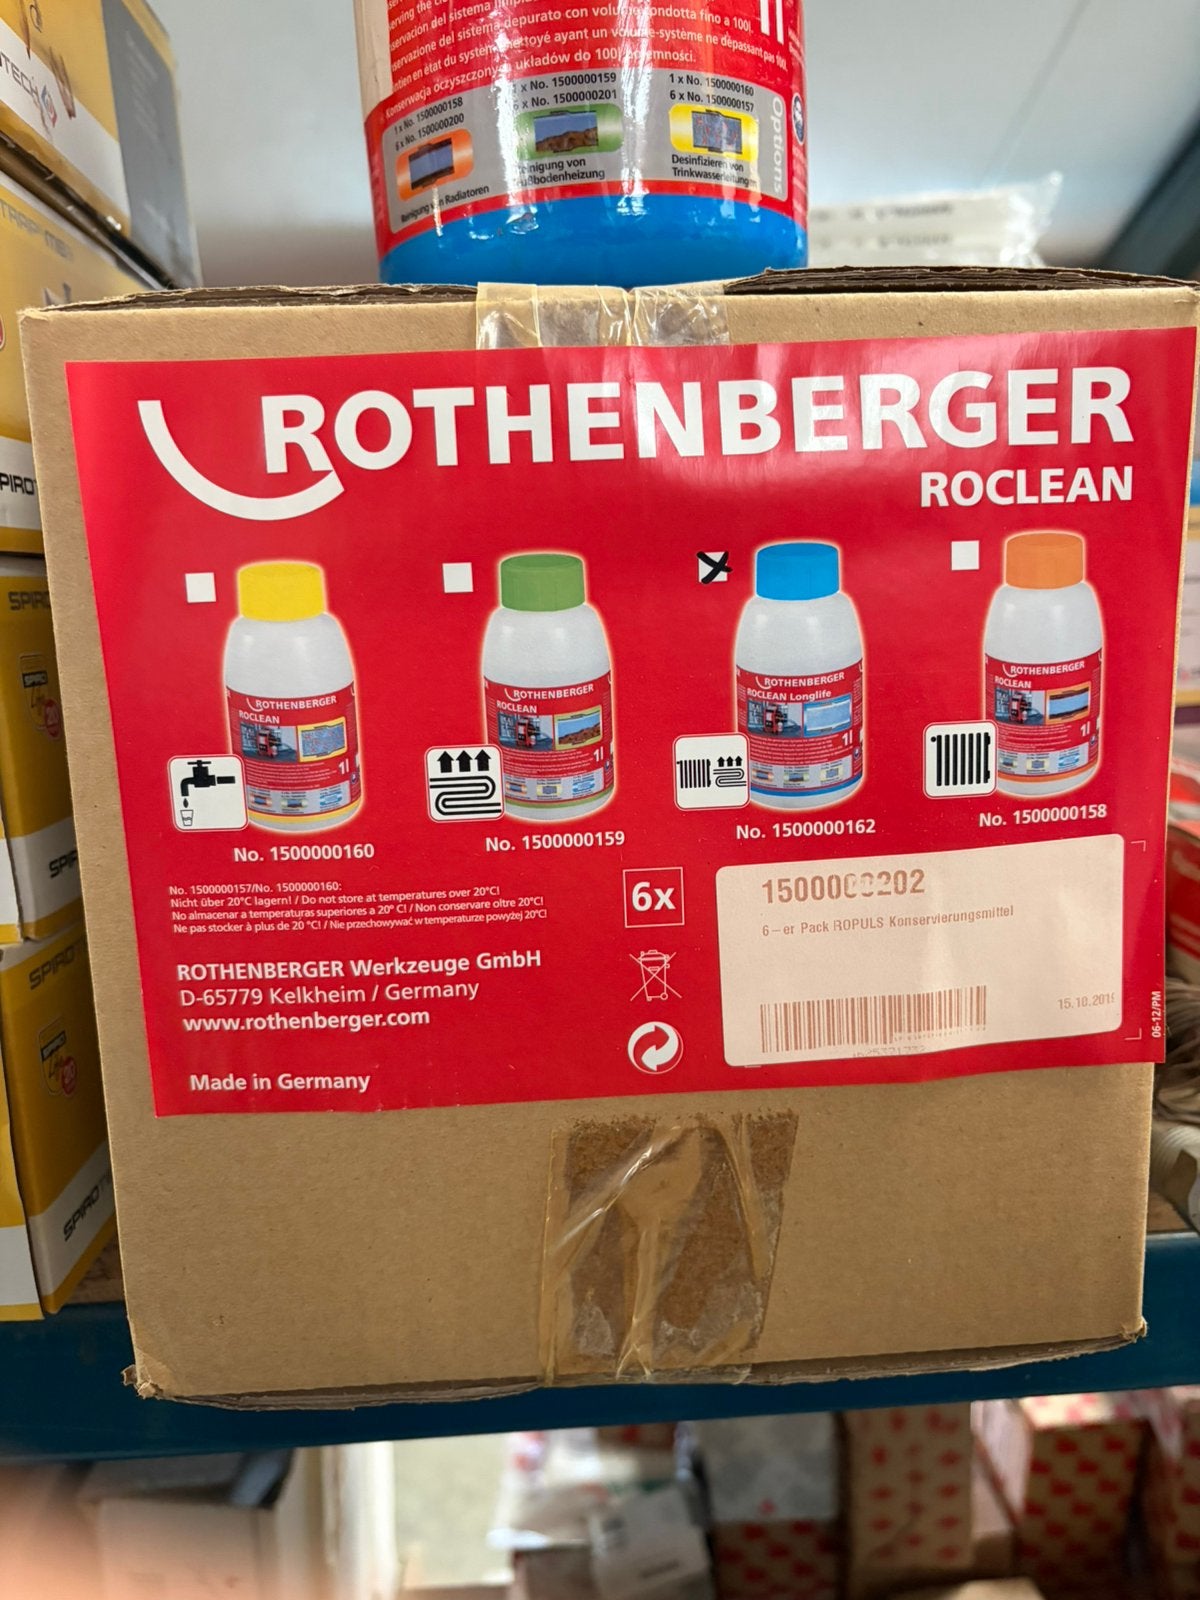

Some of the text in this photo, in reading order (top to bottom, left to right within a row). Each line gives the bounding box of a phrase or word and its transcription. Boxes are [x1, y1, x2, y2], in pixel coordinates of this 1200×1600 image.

[431, 13, 447, 30] del
[448, 2, 491, 21] sistema
[438, 31, 455, 49] del
[457, 20, 500, 42] sistema
[503, 11, 561, 29] depurato
[565, 8, 589, 19] con
[700, 10, 721, 24] fino
[724, 17, 730, 26] a
[412, 67, 423, 81] en
[444, 53, 457, 68] du
[554, 28, 589, 44] ayant
[592, 28, 608, 39] un
[705, 33, 719, 45] ne
[515, 53, 570, 72] układów
[573, 50, 591, 62] do
[520, 83, 528, 92] x
[530, 79, 549, 91] No.
[552, 72, 617, 88] 1500000159
[669, 73, 754, 97] 1 x No. 1500000160
[521, 99, 529, 109] x
[531, 96, 550, 107] No.
[553, 88, 617, 104] 1500000201
[669, 89, 754, 113] 6 x No. 1500000157
[404, 116, 416, 130] No.
[416, 97, 464, 122] 1500000158
[405, 132, 417, 145] No.
[418, 113, 465, 138] 1500000200
[772, 95, 783, 194] Options
[566, 159, 586, 169] von
[671, 154, 728, 172] Desinfizieren
[444, 184, 490, 206] Radiatoren
[262, 366, 1135, 488] ROTHENBERGER
[920, 466, 1133, 508] ROCLEAN
[764, 671, 845, 687] ROTHENBERGER
[1010, 660, 1085, 676] ROTHENBERGER
[513, 684, 594, 700] ROTHENBERGER
[994, 676, 1032, 689] ROCLEAN
[255, 696, 337, 711] ROTHENBERGER
[747, 688, 832, 702] ROCLEAN Longlife
[238, 710, 280, 724] ROCLEAN
[496, 700, 537, 714] ROCLEAN
[978, 804, 1107, 828] No. 1500000158
[736, 818, 876, 840] No. 1500000162
[485, 830, 625, 852] No. 1500000159
[233, 843, 375, 863] No. 1500000160
[169, 881, 342, 895] No. 1500000157/No. 1500000160:
[631, 882, 676, 912] 6x
[762, 868, 926, 904] 1500000202
[170, 898, 199, 908] Nicht
[200, 897, 226, 907] über
[228, 896, 252, 907] 20°C
[301, 895, 316, 905] Do
[318, 895, 336, 905] not
[338, 894, 364, 904] store
[366, 893, 377, 903] at
[378, 890, 447, 904] temperatures
[449, 889, 471, 899] over
[172, 911, 187, 921] No
[189, 909, 238, 920] almacenar
[240, 911, 247, 919] a
[249, 908, 315, 921] temperaturas
[316, 906, 367, 919] superiores
[369, 907, 376, 915] a
[415, 903, 436, 913] Non
[438, 901, 491, 912] conservare
[493, 899, 516, 909] oltre
[800, 920, 830, 934] Pack
[833, 916, 885, 931] ROPULS
[889, 905, 1015, 929] Konservierungsmittel
[173, 924, 188, 934] Ne
[189, 924, 207, 935] pas
[208, 922, 243, 933] stocker
[246, 922, 253, 932] à
[254, 921, 276, 933] plus
[277, 921, 290, 931] de
[292, 921, 304, 930] 20
[329, 919, 345, 930] Nie
[346, 917, 413, 931] przechowywać
[414, 918, 423, 926] w
[424, 914, 485, 927] temperaturze
[486, 911, 523, 924] powyżej
[177, 949, 542, 982] ROTHENBERGER Werkzeuge GmbH
[179, 981, 480, 1007] D-65779 Kelkheim / Germany
[183, 1009, 431, 1032] www.rothenberger.com
[1151, 990, 1162, 1039] 06-12/PM
[189, 1072, 371, 1094] Made in Germany
